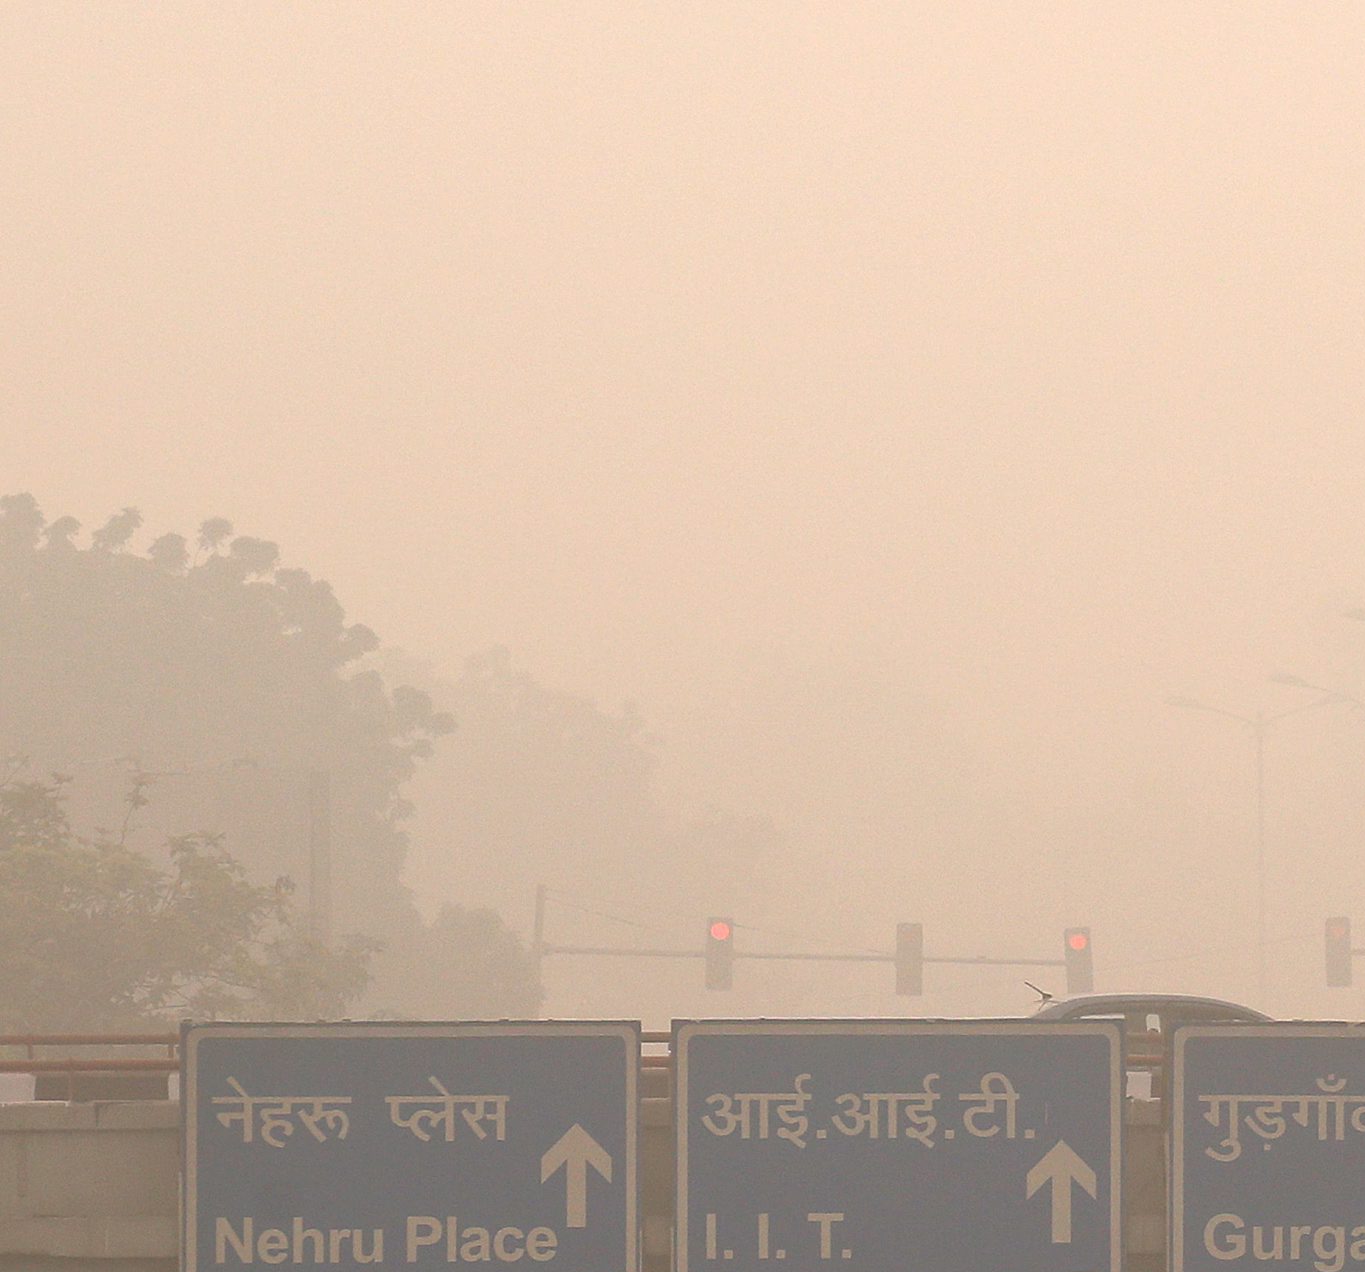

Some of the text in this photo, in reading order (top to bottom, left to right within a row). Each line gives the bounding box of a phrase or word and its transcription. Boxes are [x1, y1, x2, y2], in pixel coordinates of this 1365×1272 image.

[212, 1075, 510, 1149] नेहरू प्लेस
[702, 1072, 1035, 1149] आई.आई.टी.
[214, 1215, 558, 1264] Nehru Place
